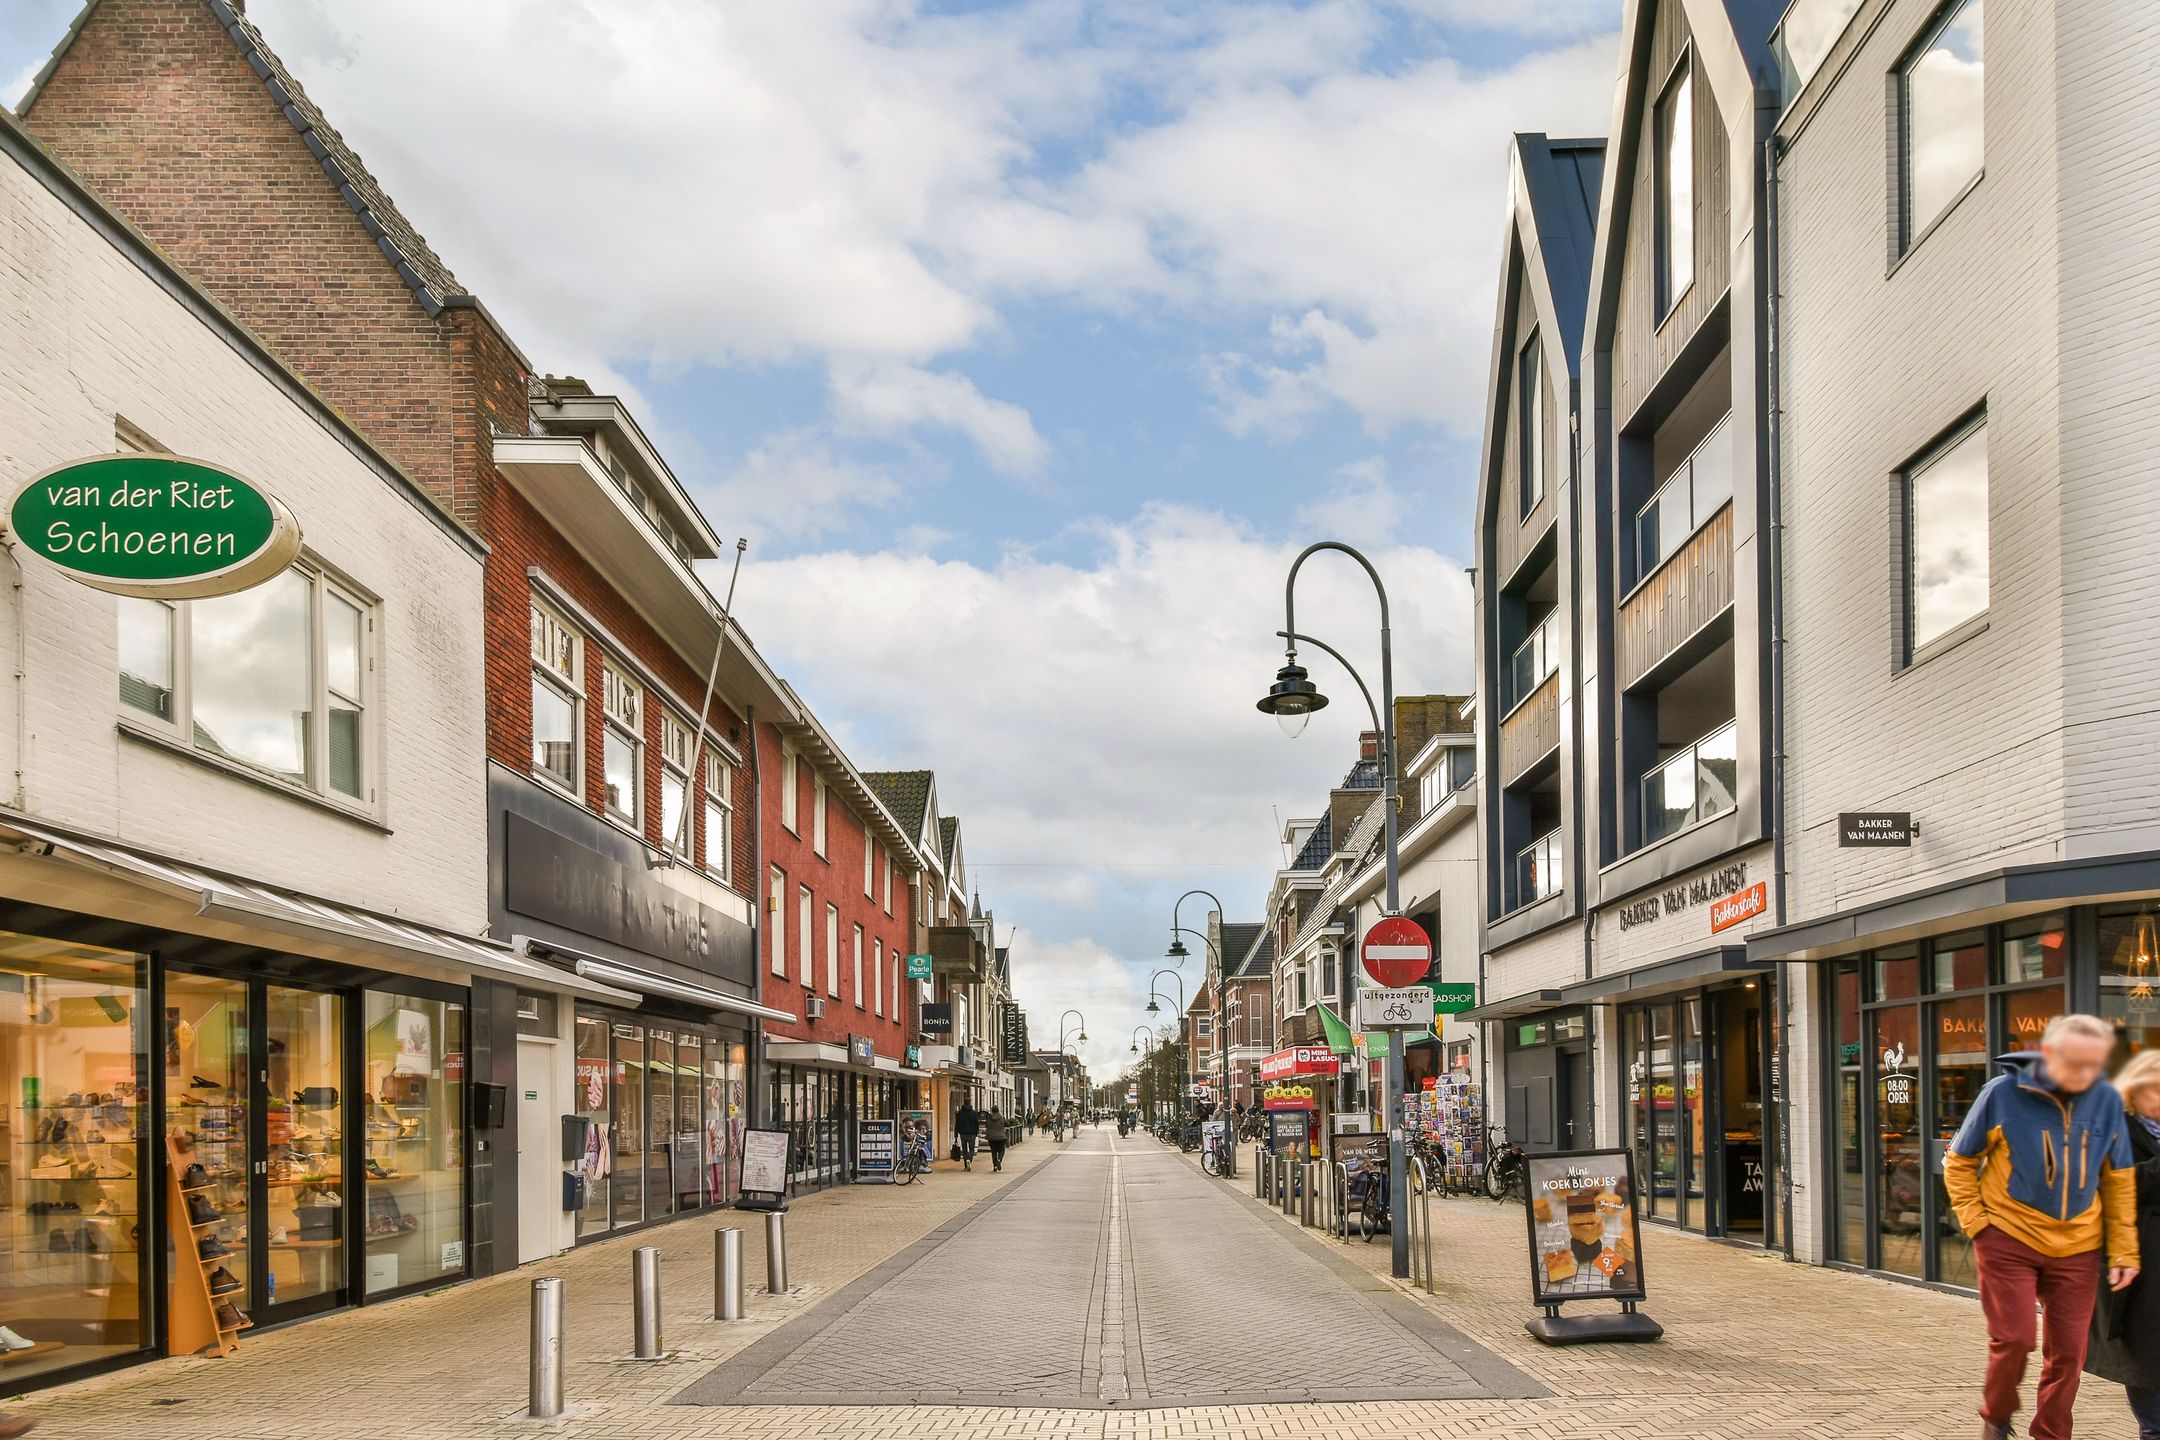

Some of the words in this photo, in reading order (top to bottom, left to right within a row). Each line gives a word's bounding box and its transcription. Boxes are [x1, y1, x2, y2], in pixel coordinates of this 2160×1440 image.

[47, 487, 100, 507] van
[109, 479, 162, 508] der
[170, 481, 235, 509] Riet
[47, 521, 235, 556] Schoenen
[1858, 819, 1893, 828] BAKKER
[1847, 831, 1865, 840] VAN
[1867, 831, 1905, 840] MAANEN
[1619, 896, 1660, 932] BAKKER
[1662, 884, 1687, 916] VAN
[1687, 861, 1747, 907] MAANEN
[908, 965, 930, 973] Pearle
[1364, 990, 1430, 1001] uitgezonderd
[1007, 1005, 1016, 1049] MELMAN
[2016, 1016, 2050, 1033] VAN
[1887, 1080, 1908, 1091] 08:00
[1887, 1091, 1909, 1104] OPEN
[1567, 1166, 1590, 1178] Mini
[1542, 1179, 1571, 1191] KOEK
[1572, 1176, 1617, 1189] BLOKJES
